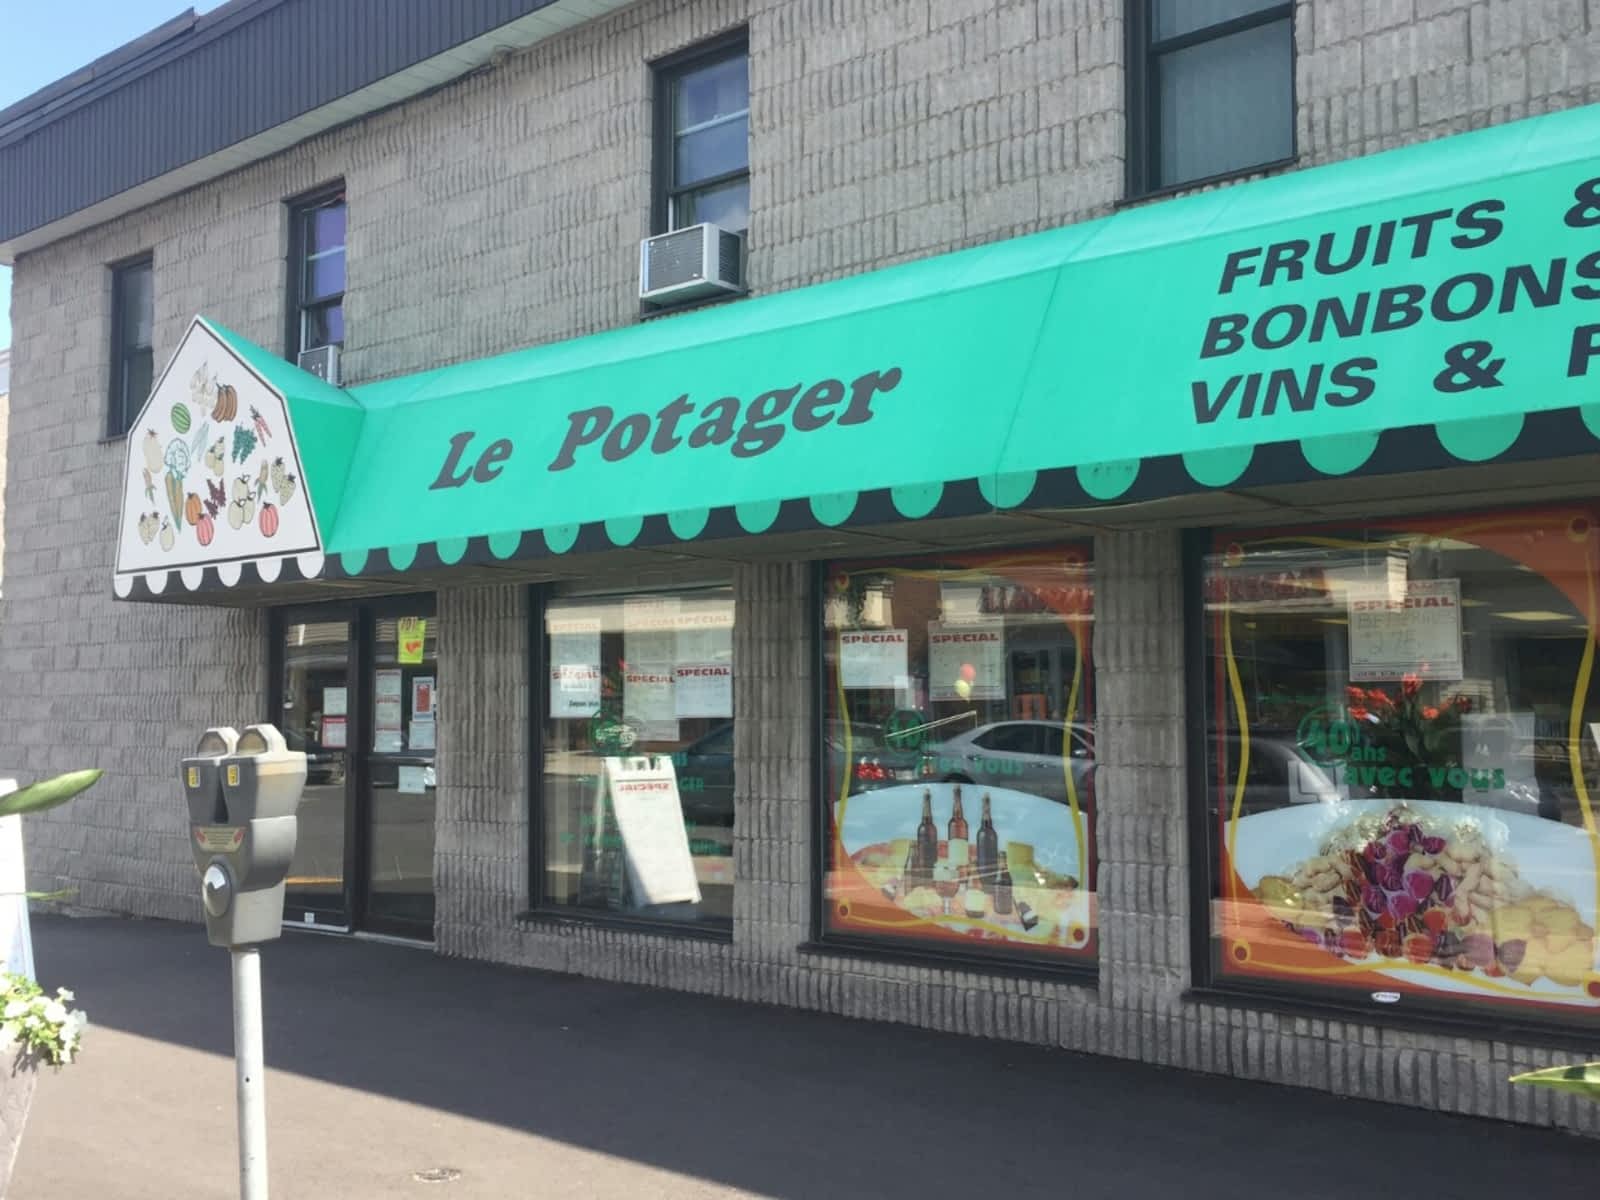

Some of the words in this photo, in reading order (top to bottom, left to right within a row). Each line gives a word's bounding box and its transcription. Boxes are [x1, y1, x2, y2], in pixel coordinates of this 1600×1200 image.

[1217, 199, 1506, 295] FRUITS
[1191, 357, 1379, 425] VINS
[1433, 340, 1507, 393] &
[428, 431, 513, 490] Le
[547, 367, 903, 472] Potager
[1305, 719, 1350, 755] 40
[1351, 747, 1387, 761] ans
[1343, 766, 1413, 787] avec
[1428, 767, 1505, 789] vous
